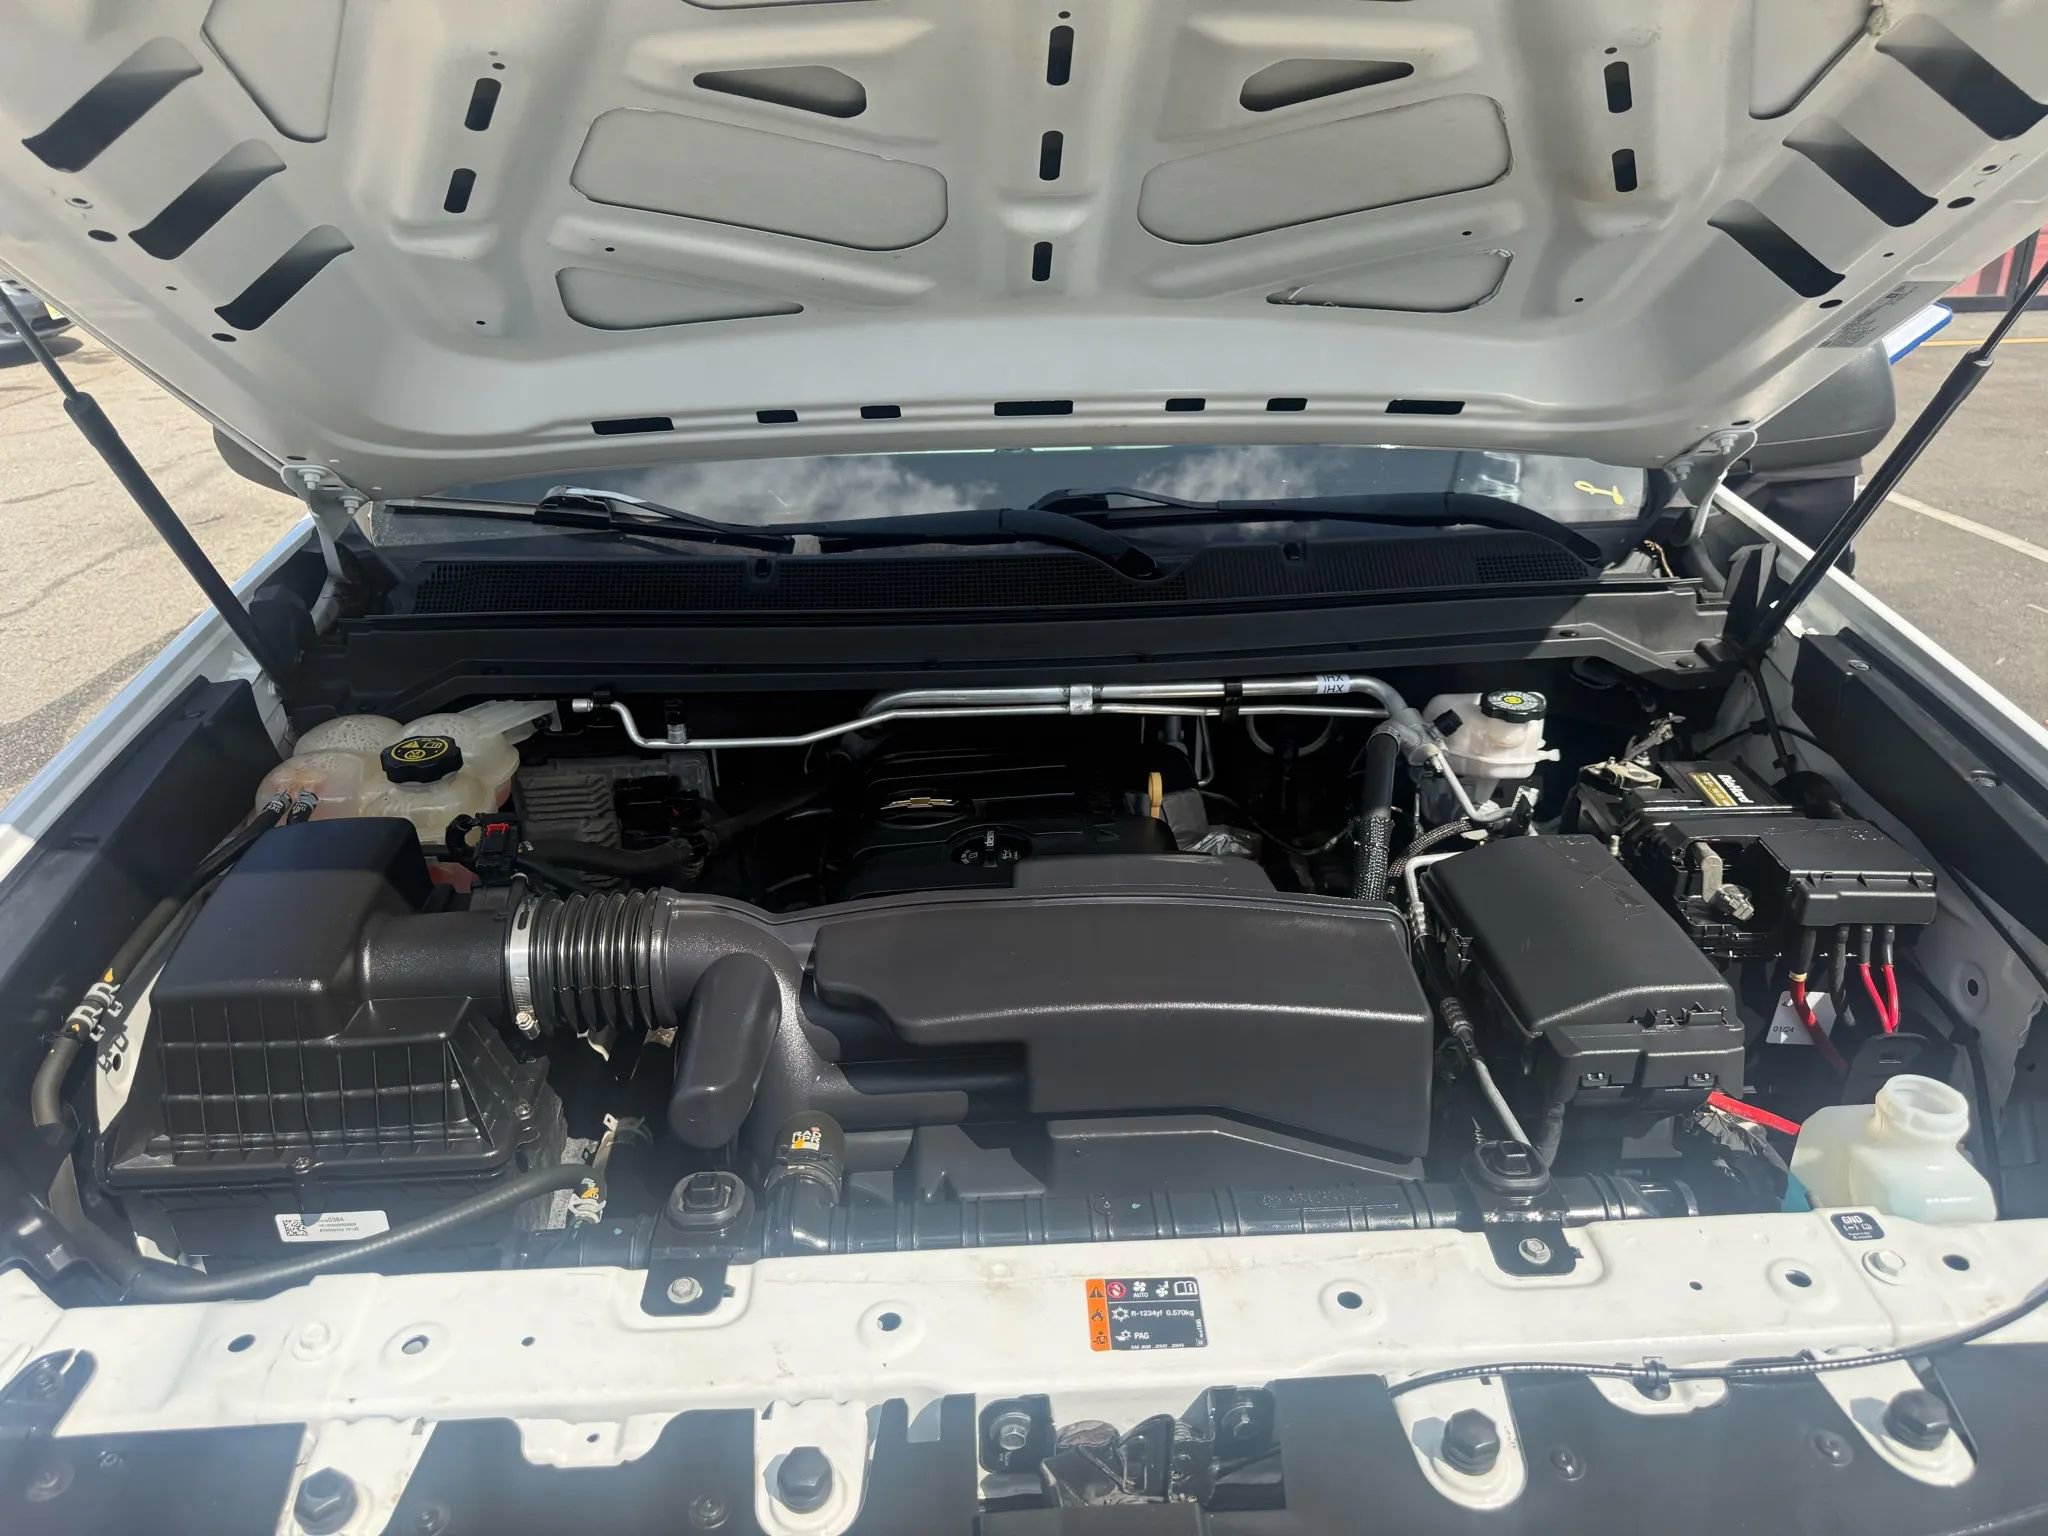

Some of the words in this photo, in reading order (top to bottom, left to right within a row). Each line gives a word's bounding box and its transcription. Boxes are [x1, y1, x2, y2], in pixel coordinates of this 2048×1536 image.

[1717, 774, 1755, 803] DieHard
[1841, 1215, 1863, 1224] GND
[1130, 1309, 1163, 1318] R-1234yf
[1165, 1309, 1195, 1317] 0.570kg
[1134, 1332, 1150, 1340] PAG
